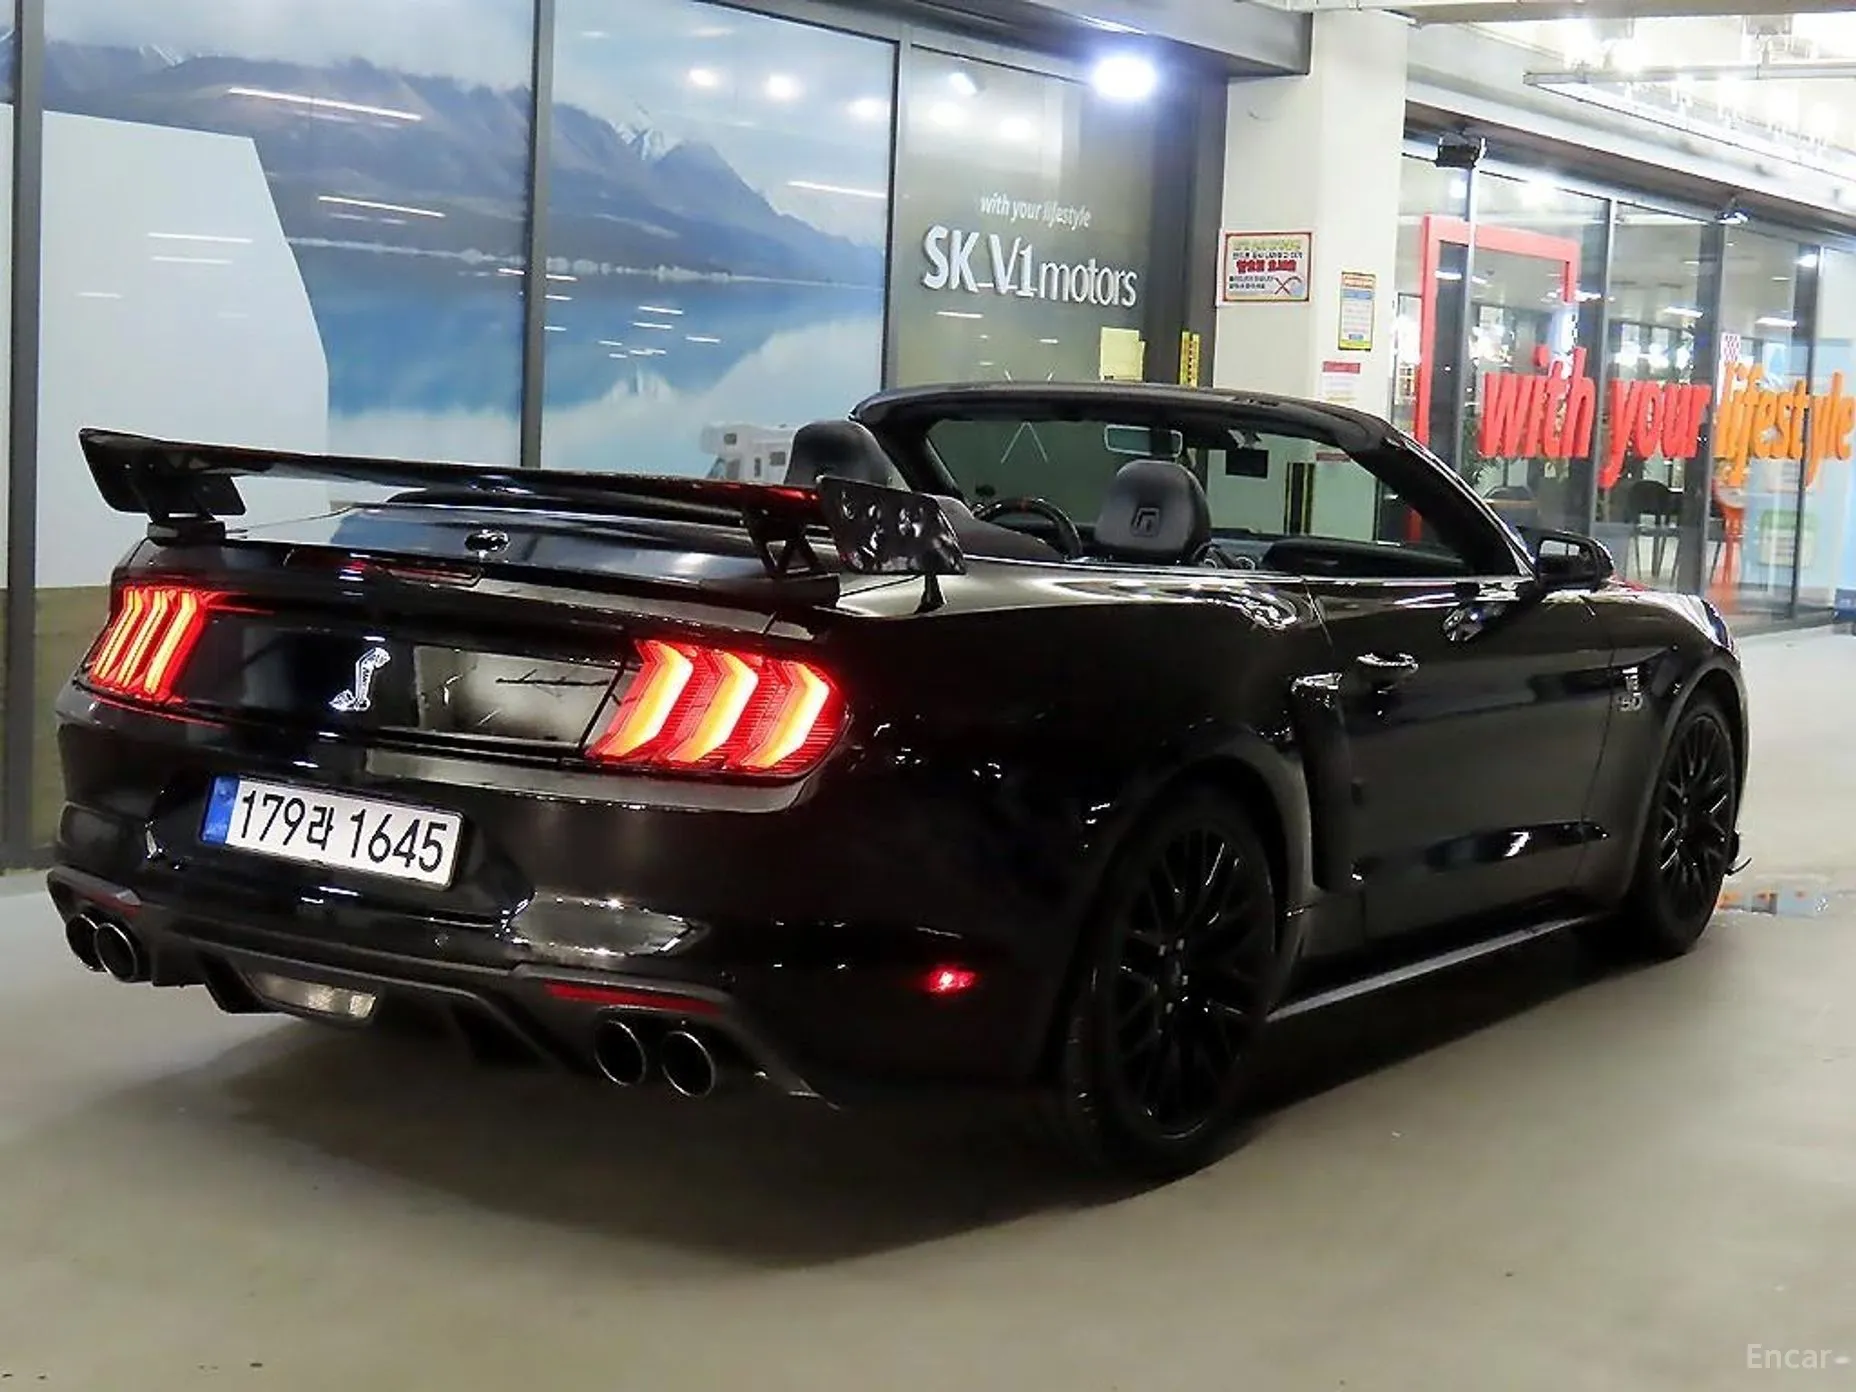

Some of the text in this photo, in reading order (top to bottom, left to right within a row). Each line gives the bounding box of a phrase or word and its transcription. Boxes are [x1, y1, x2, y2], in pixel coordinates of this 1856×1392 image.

[980, 192, 1010, 216] with
[1009, 200, 1042, 223] your
[922, 224, 979, 293] SK
[1478, 345, 1596, 459] with
[1597, 379, 1712, 490] your
[240, 789, 447, 873] 179라 1645
